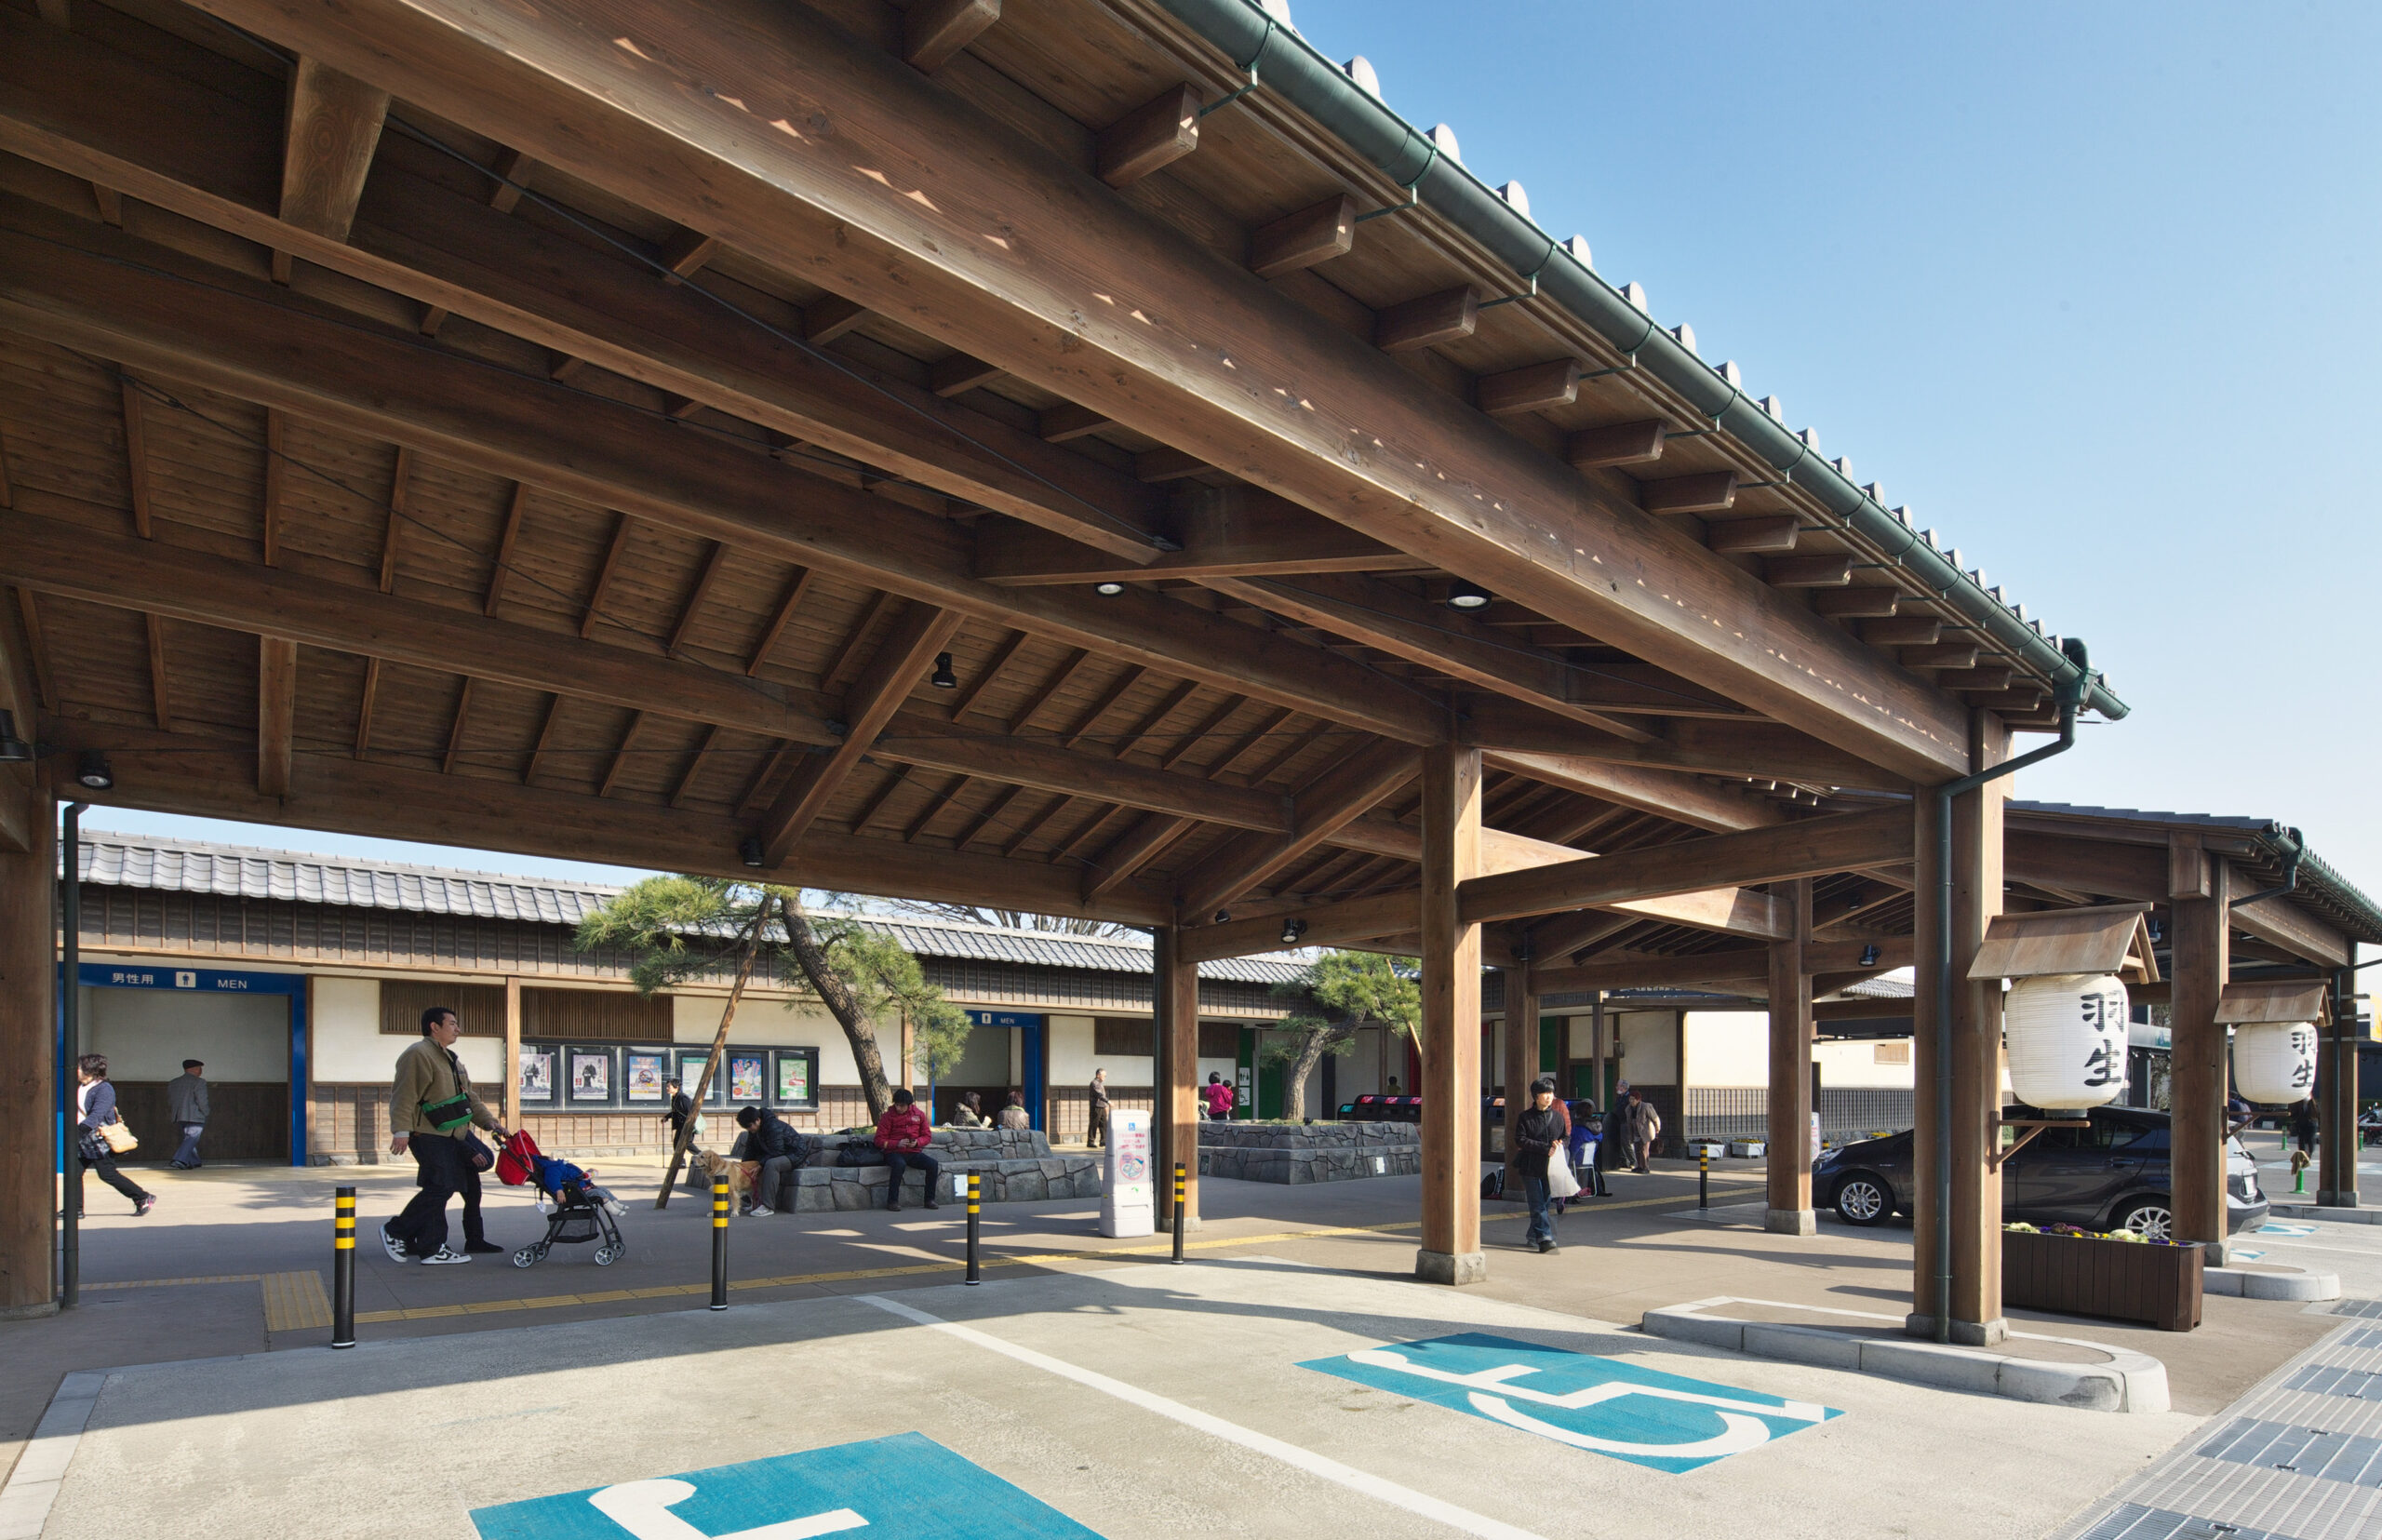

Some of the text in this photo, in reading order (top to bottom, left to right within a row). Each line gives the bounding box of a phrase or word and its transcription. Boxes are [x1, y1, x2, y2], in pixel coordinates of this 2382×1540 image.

[112, 972, 248, 989] 男性用 MEN
[2080, 990, 2124, 1087] 羽生
[2291, 1029, 2317, 1088] 羽生
